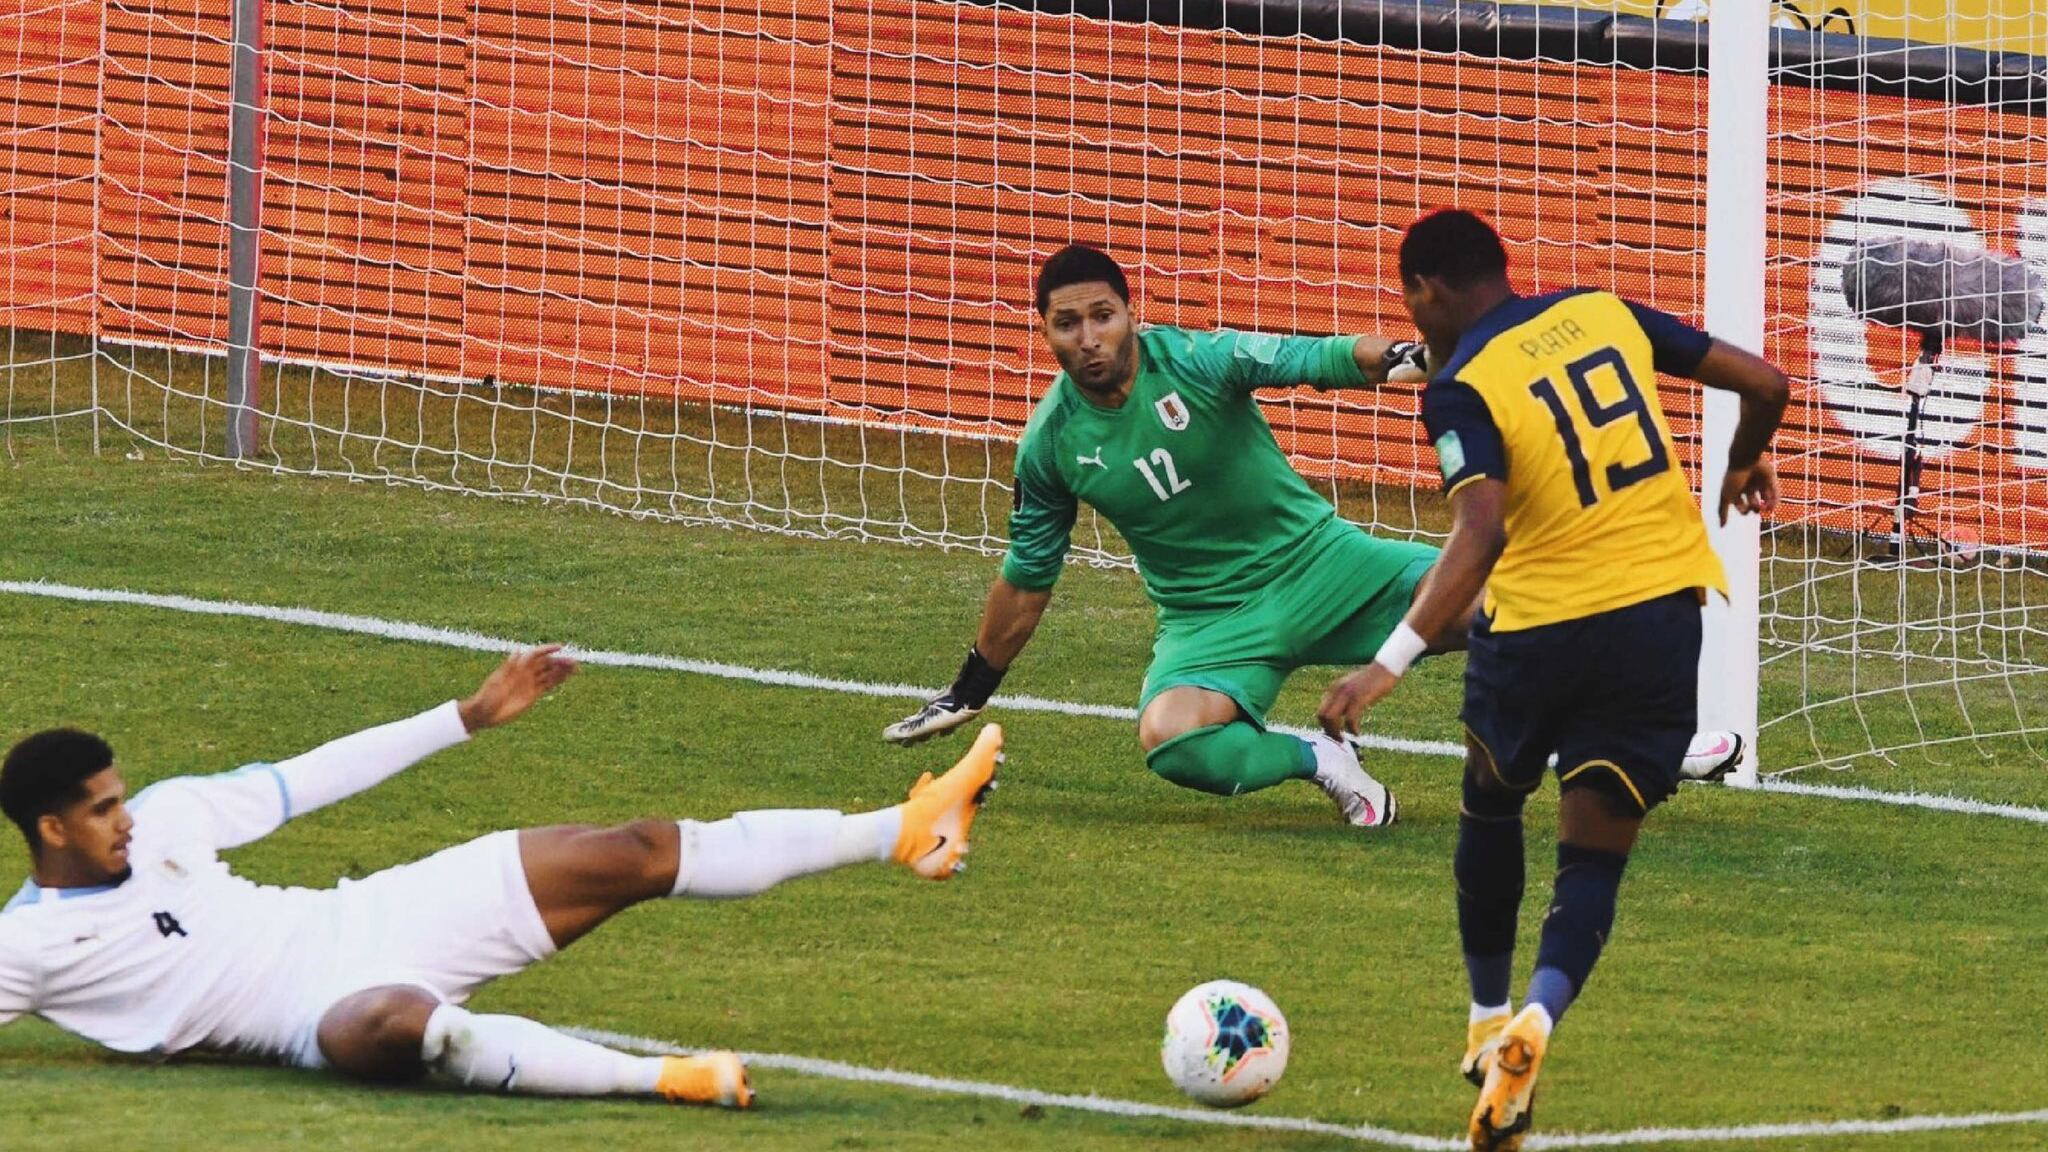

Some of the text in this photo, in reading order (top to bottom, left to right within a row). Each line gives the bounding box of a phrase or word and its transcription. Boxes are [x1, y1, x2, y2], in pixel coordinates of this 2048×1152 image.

[1519, 318, 1587, 360] PLATA
[1528, 345, 1670, 509] 19
[1133, 447, 1192, 501] 12
[152, 911, 188, 938] 4
